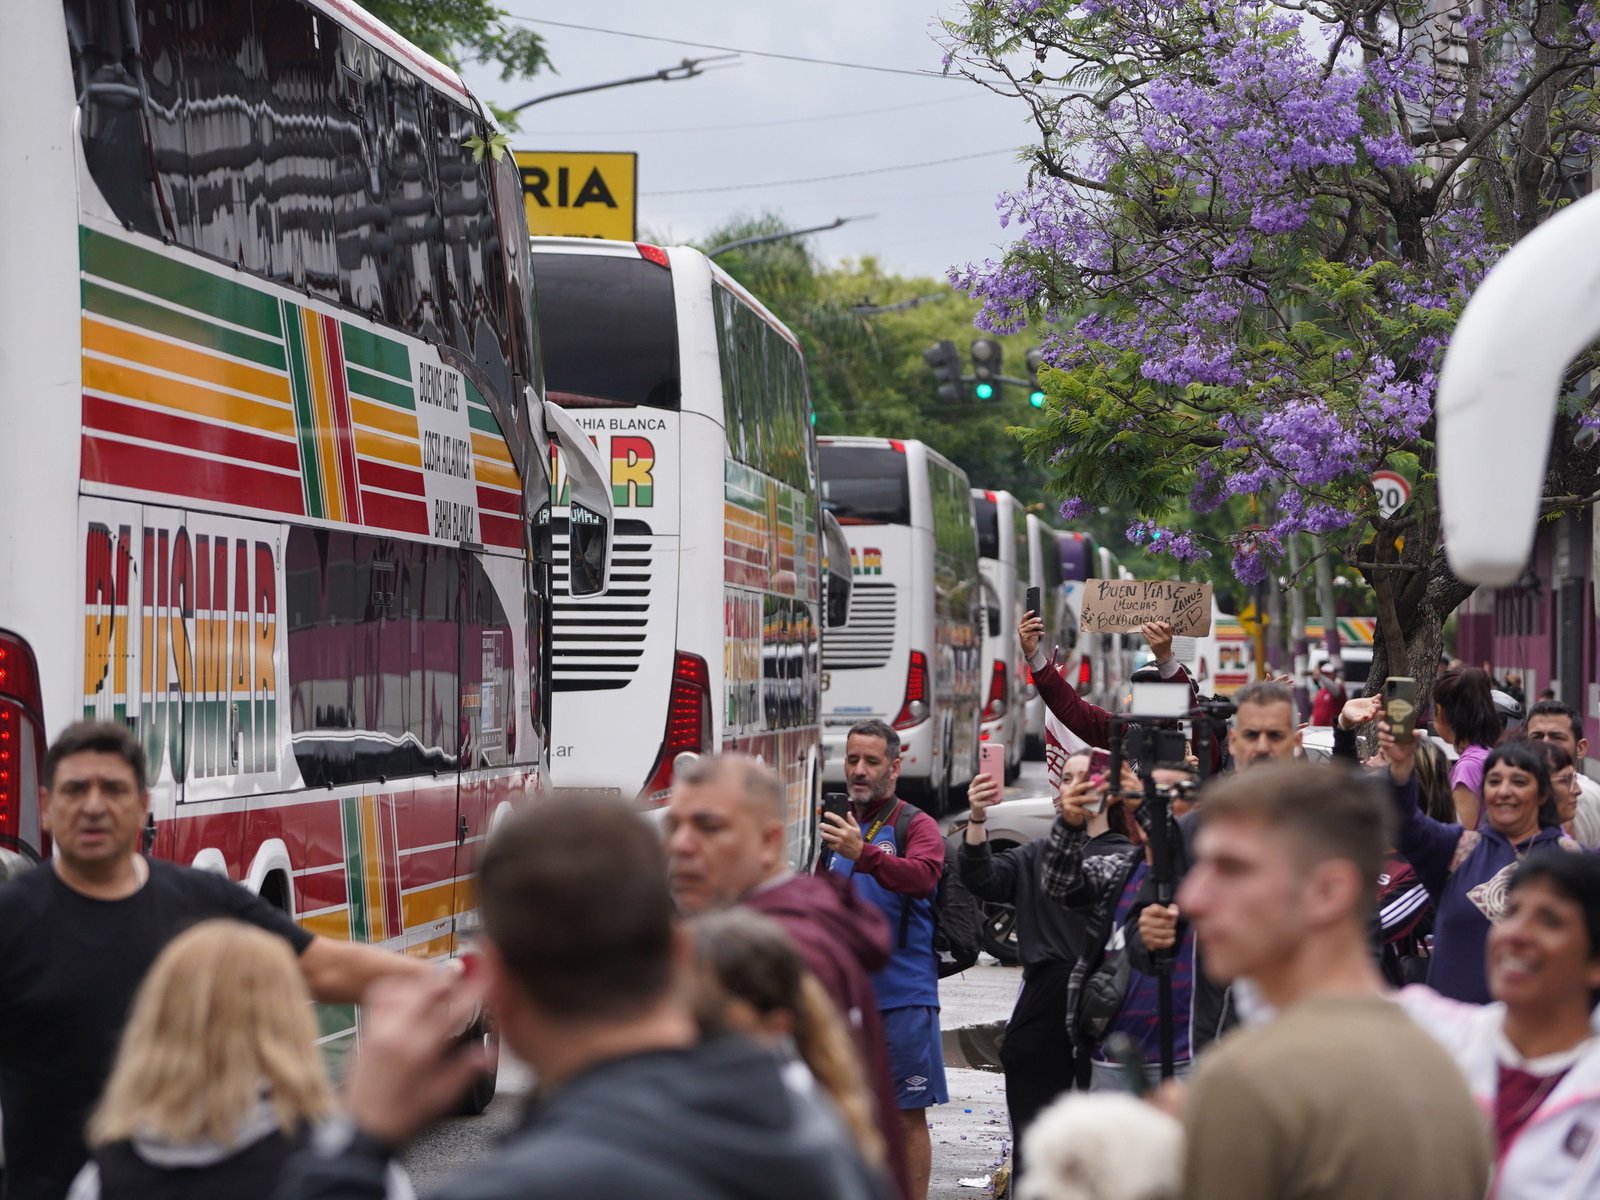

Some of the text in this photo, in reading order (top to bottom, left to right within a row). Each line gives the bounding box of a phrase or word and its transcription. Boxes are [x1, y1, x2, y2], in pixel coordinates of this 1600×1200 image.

[419, 361, 459, 412] BUENOS AIRES
[610, 418, 666, 430] BLANCA
[424, 430, 471, 480] COSTA ATLANTICA
[435, 499, 474, 543] BAHIA BLANCA
[1098, 581, 1137, 600] BUEN
[1171, 588, 1203, 613] LANUS
[1113, 599, 1158, 612] MUCHAS
[552, 745, 574, 757] .ar
